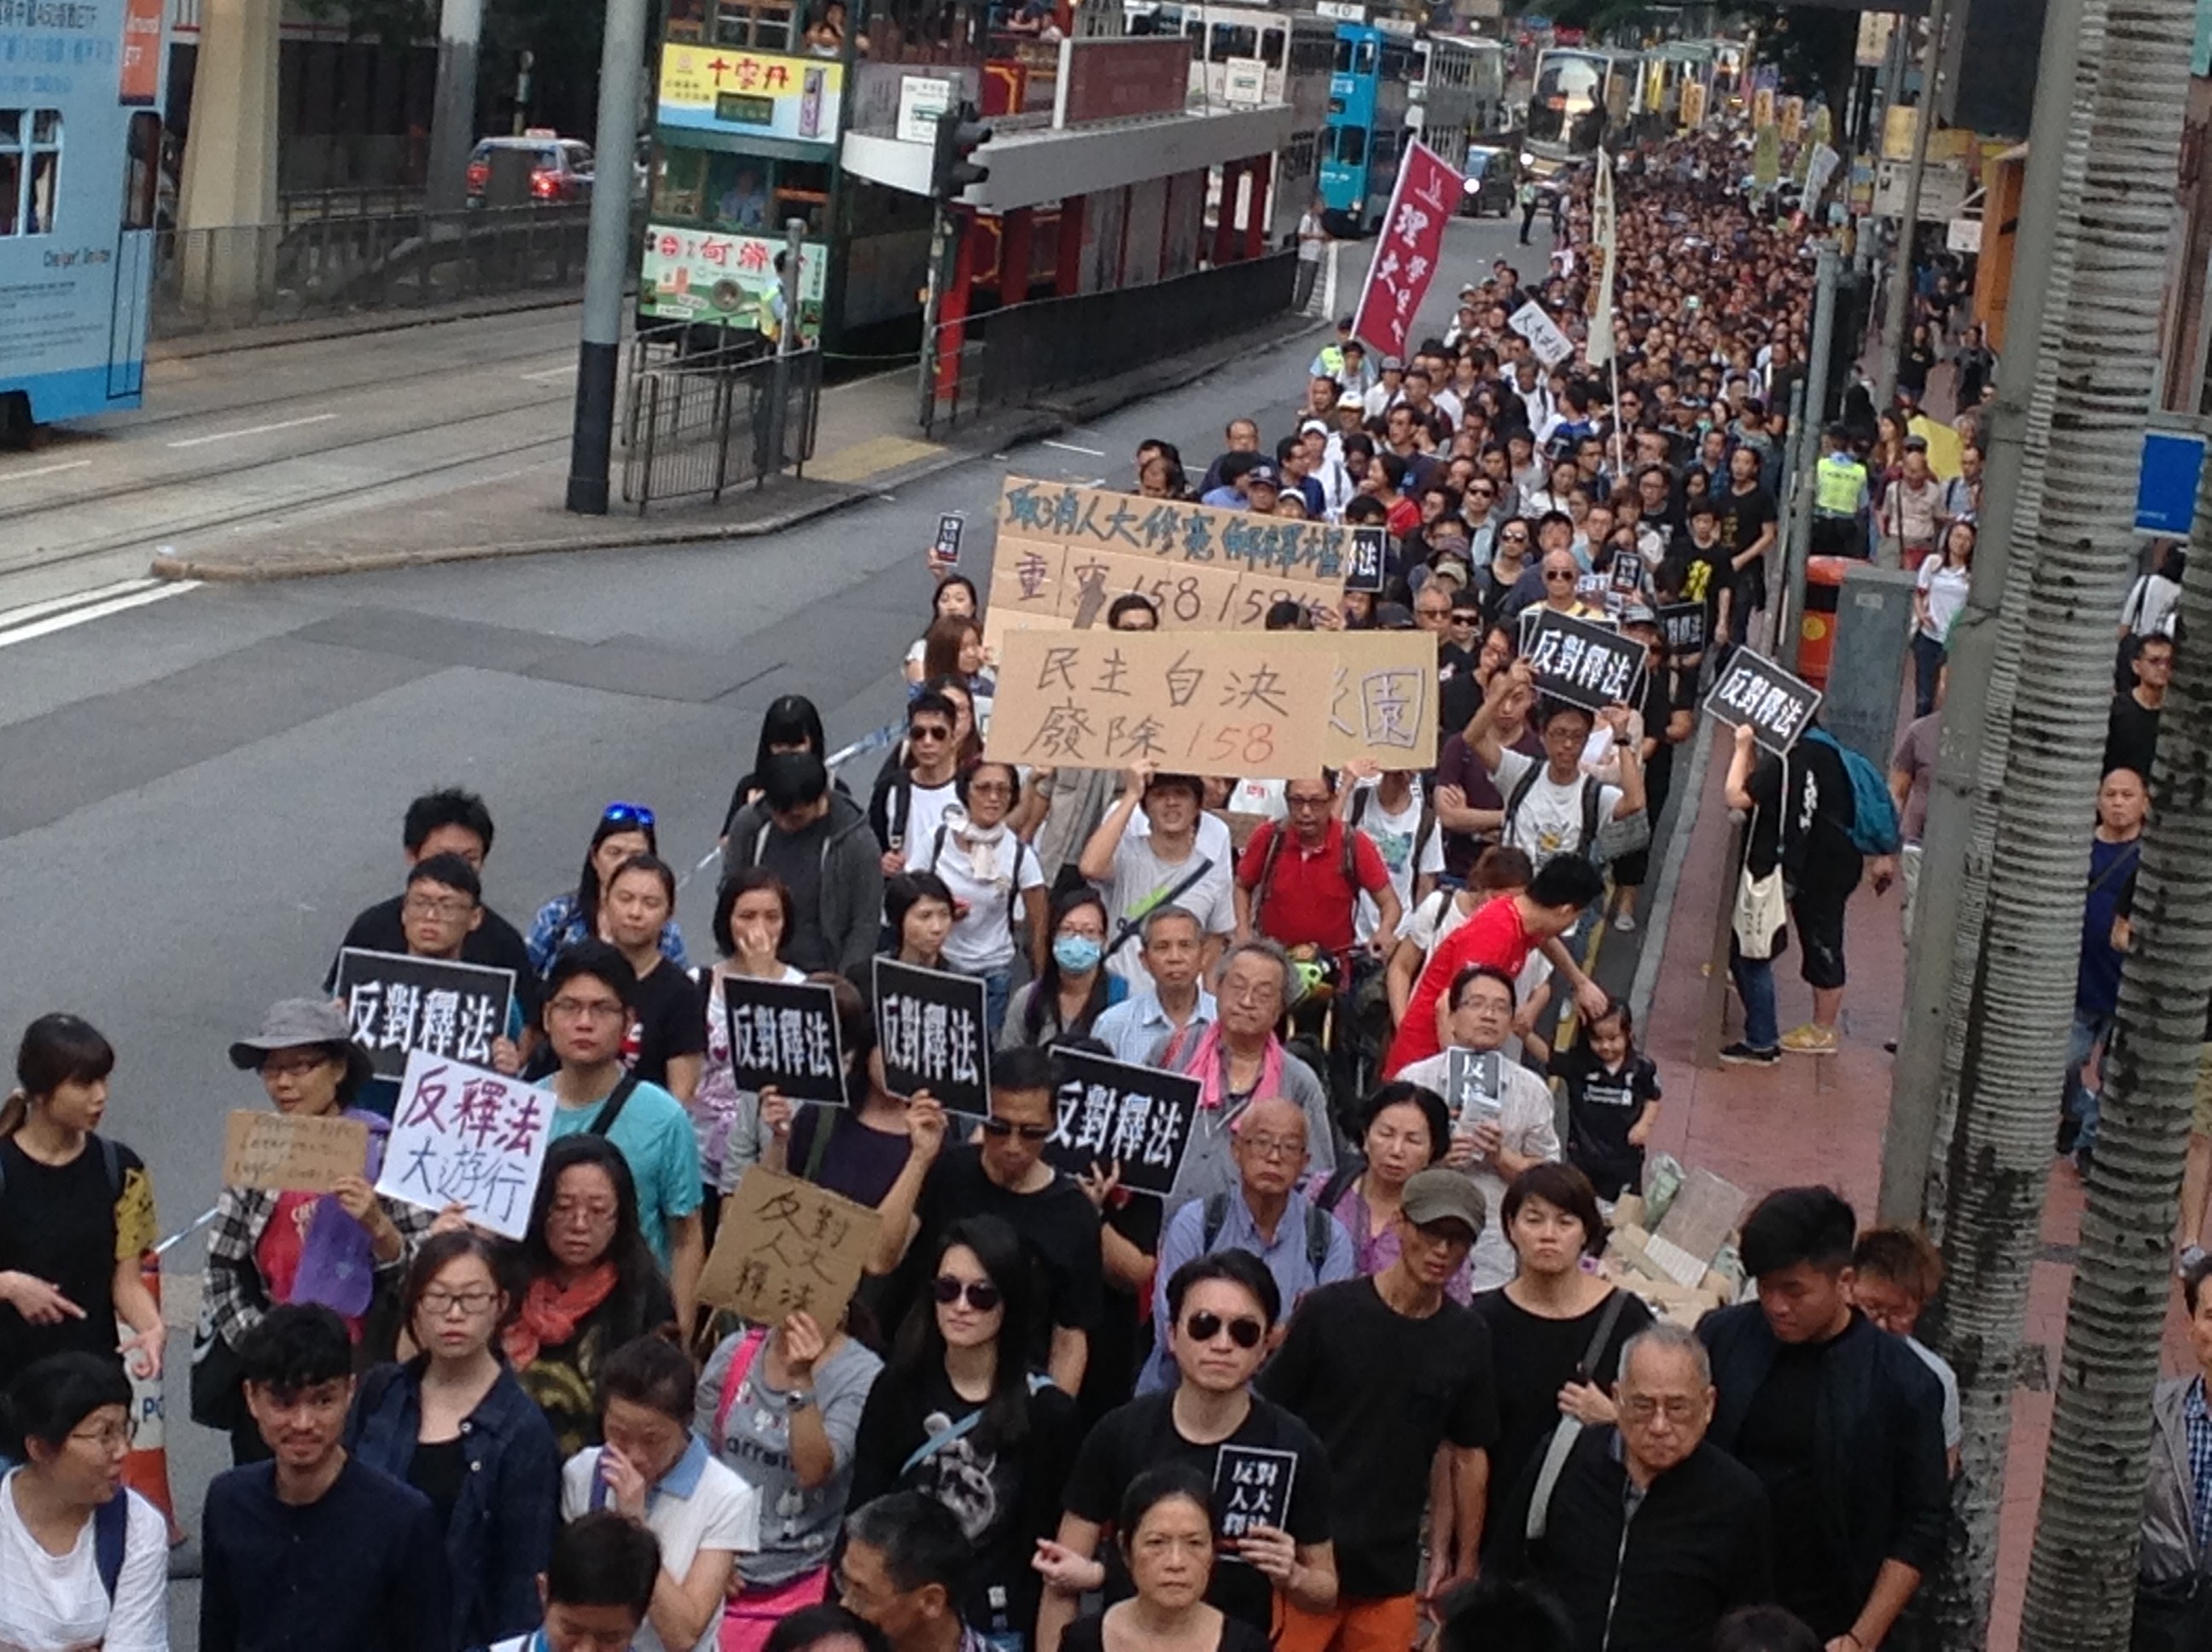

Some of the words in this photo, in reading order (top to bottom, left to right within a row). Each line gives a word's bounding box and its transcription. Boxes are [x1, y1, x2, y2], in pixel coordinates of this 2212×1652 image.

[1035, 646, 1289, 718] 民主自決
[1534, 628, 1632, 701] 反對釋法
[1718, 666, 1803, 739] 反對釋法
[347, 980, 497, 1064] 反對釋法
[733, 1003, 834, 1079] 反對釋法
[882, 992, 980, 1086] 反對釋法
[398, 1064, 541, 1158] 反釋法
[1045, 1079, 1184, 1169] 反對釋法
[400, 1136, 527, 1223] 大遊行
[1228, 1486, 1274, 1513] 人大
[1231, 1458, 1279, 1487] 反對
